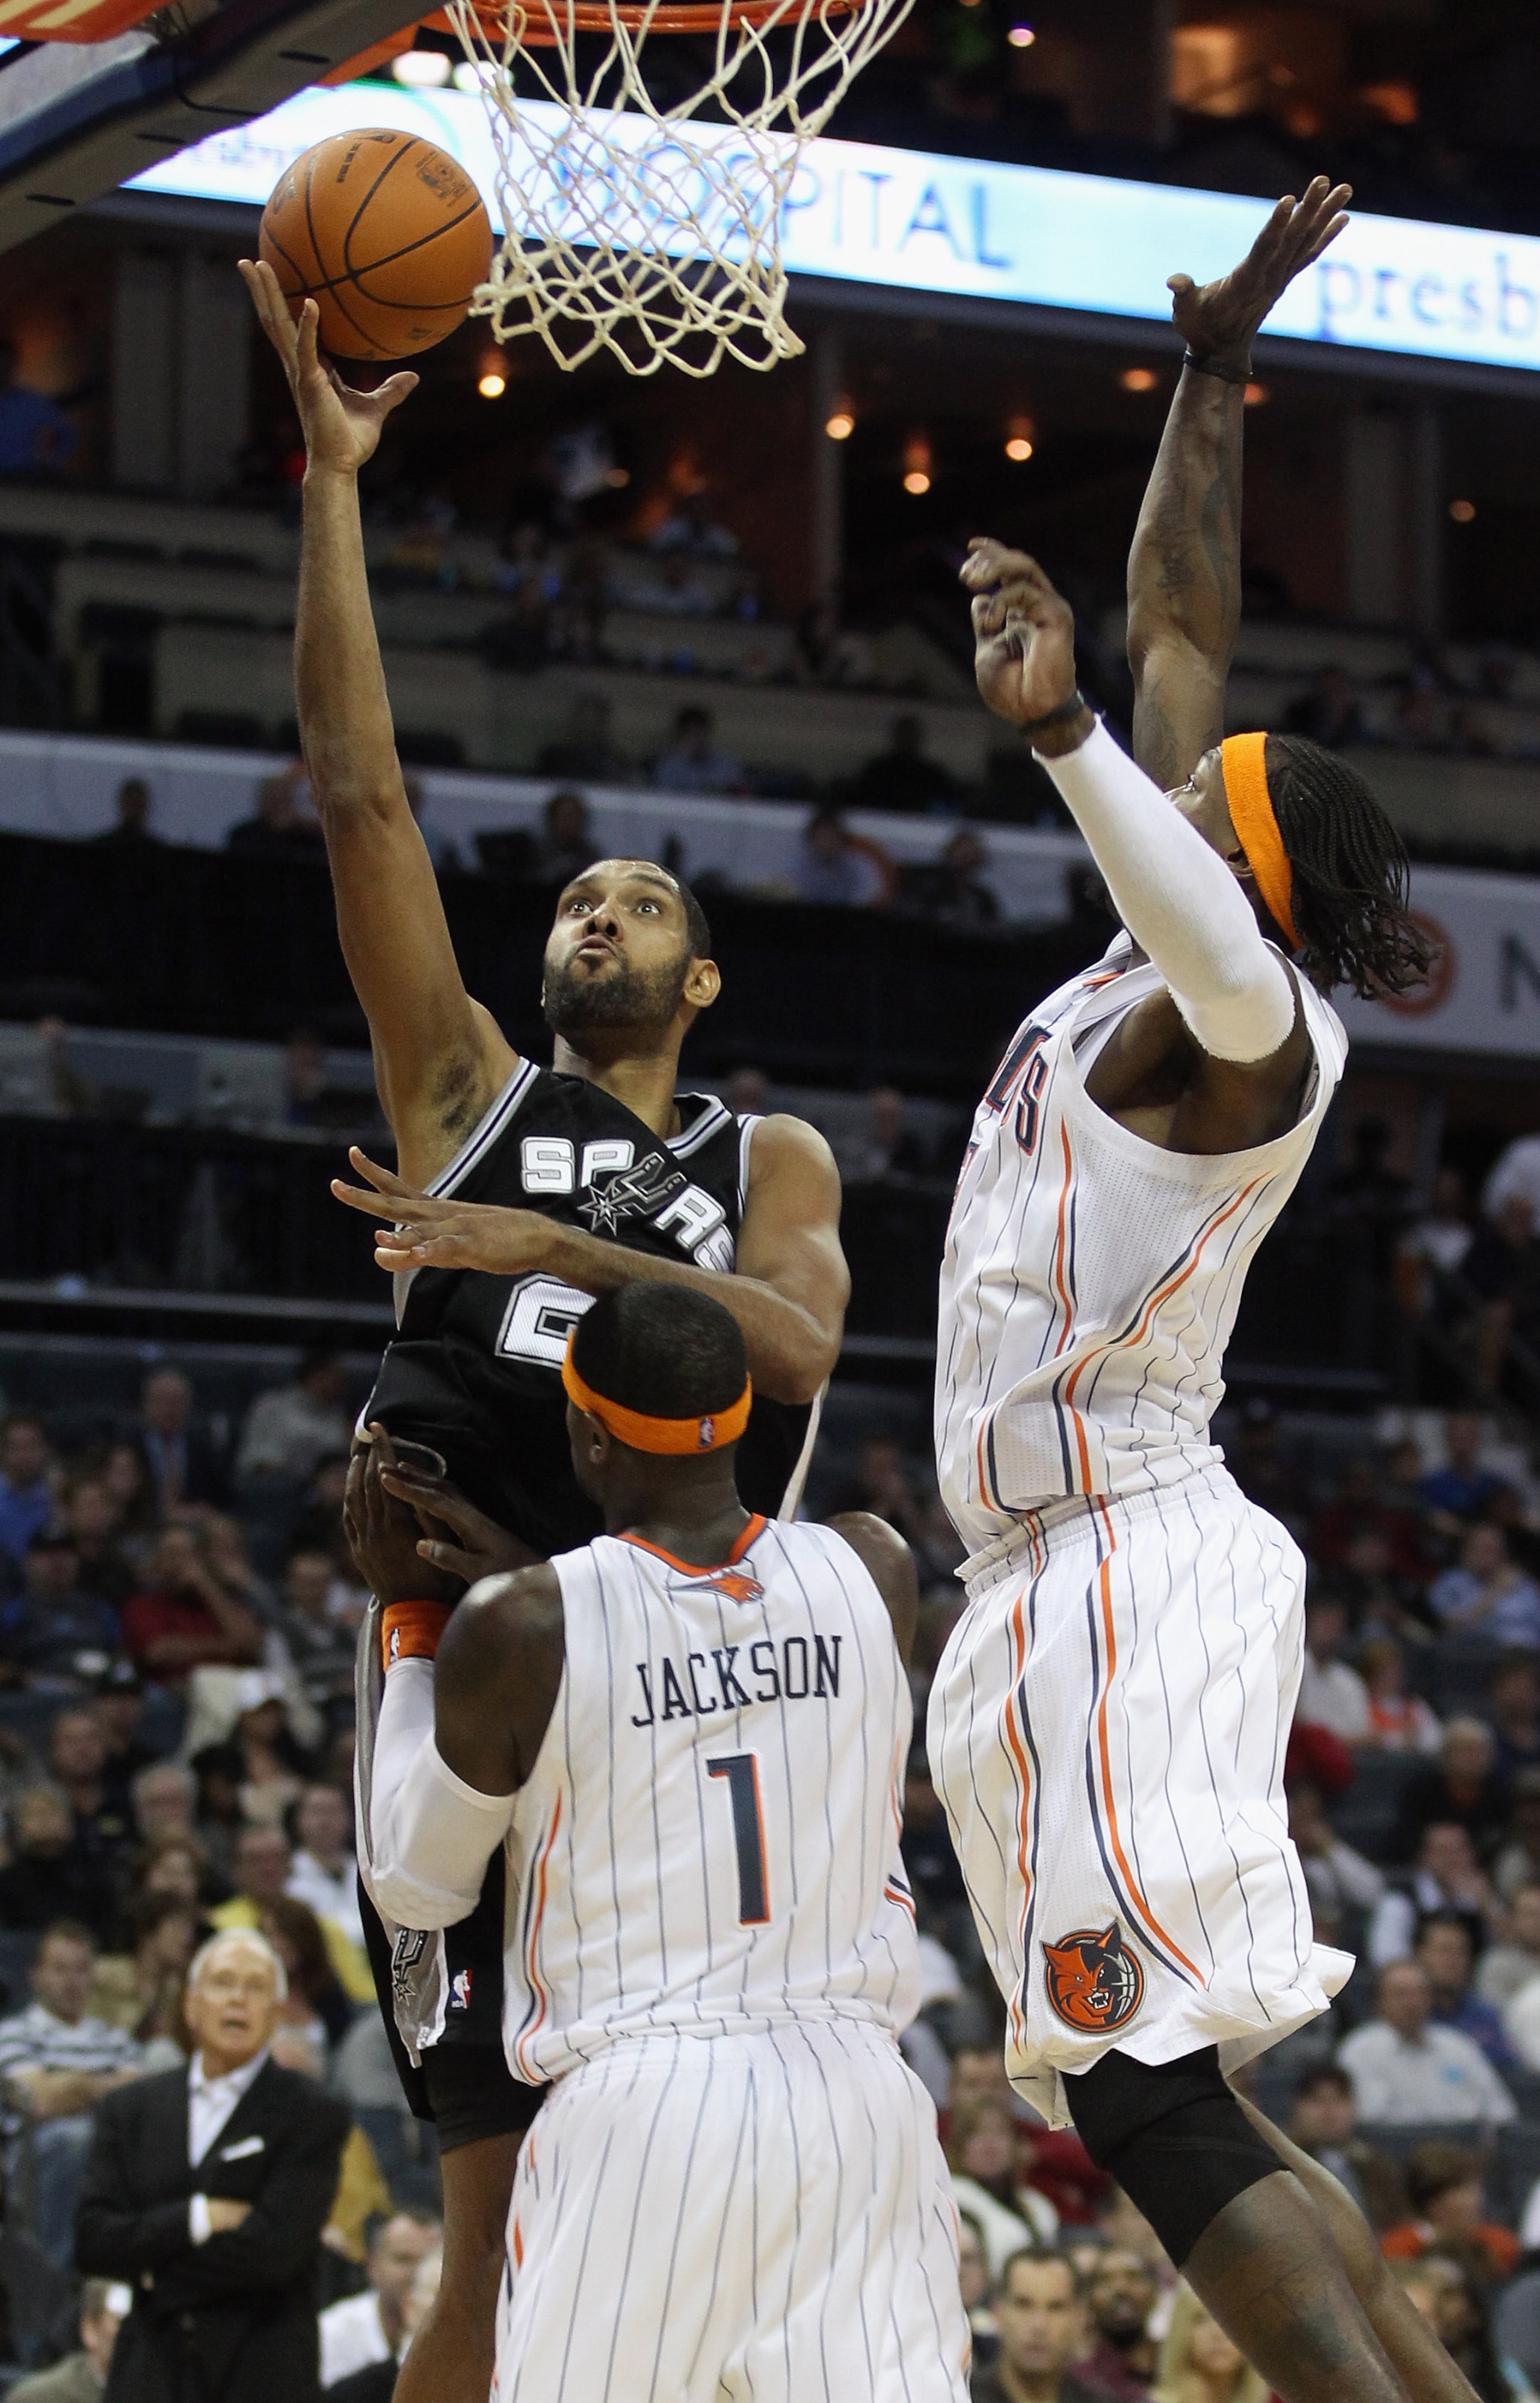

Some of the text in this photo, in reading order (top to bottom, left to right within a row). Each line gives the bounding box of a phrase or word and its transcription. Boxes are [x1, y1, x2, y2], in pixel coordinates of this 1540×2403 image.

[551, 134, 1017, 270] HOSPITAL
[632, 1635, 842, 1728] JACKSON
[706, 1753, 771, 1925] 1
